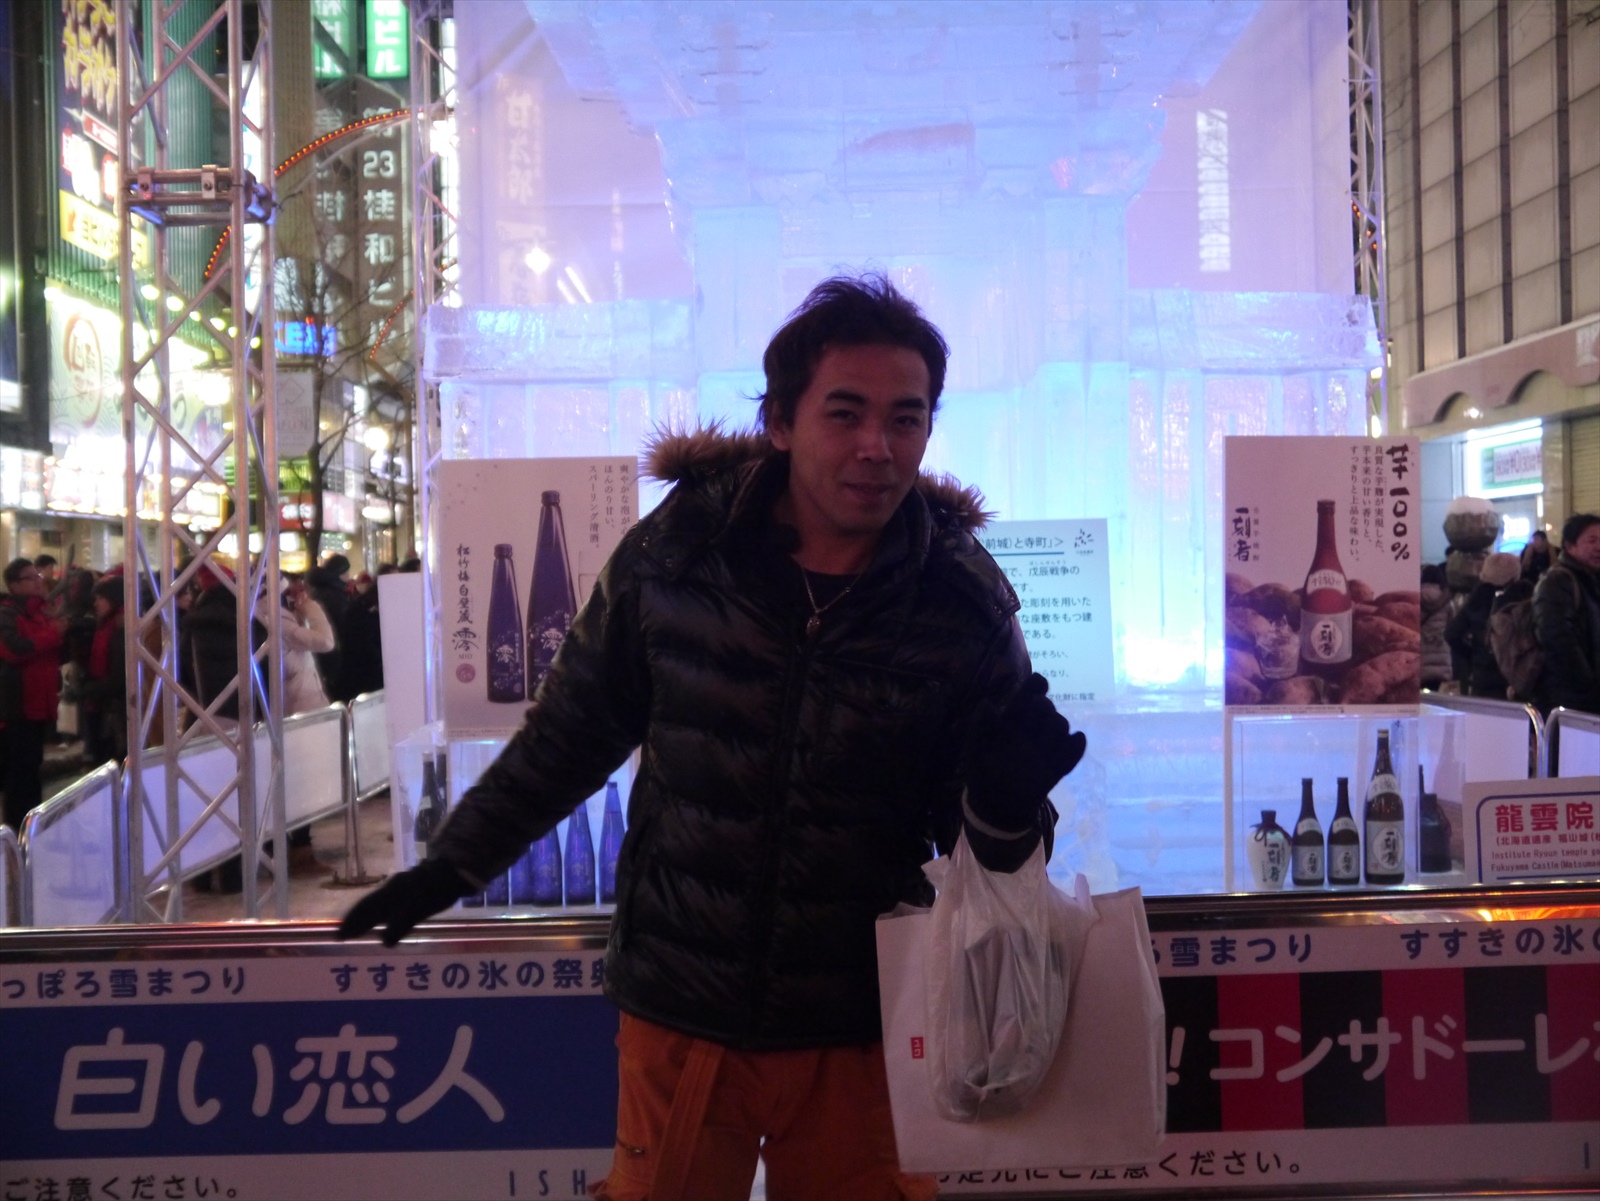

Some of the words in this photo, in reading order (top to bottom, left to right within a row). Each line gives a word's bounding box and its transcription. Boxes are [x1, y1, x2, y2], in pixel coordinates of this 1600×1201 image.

[604, 464, 615, 528] ほんのり甘い、
[1349, 445, 1360, 562] すっきりと上品な味わい。
[1362, 445, 1372, 543] 芋本来の甘い香りと、
[1231, 507, 1251, 562] 一刻者
[1018, 612, 1092, 624] な座敷をもつ建
[1021, 597, 1092, 608] た彫刻を用いた
[1023, 629, 1056, 640] である。
[1035, 669, 1069, 678] らなり、
[1495, 801, 1594, 833] 龍雲院
[1491, 850, 1531, 860] Institute
[1561, 847, 1588, 857] temple
[1491, 863, 1529, 872] Fukuyama
[2, 966, 248, 1001] っぽろ雪まつり
[1165, 1013, 1600, 1086] !コンサドーレ
[53, 1024, 506, 1131] 白い恋人
[4, 1174, 239, 1201] ご注意ください。
